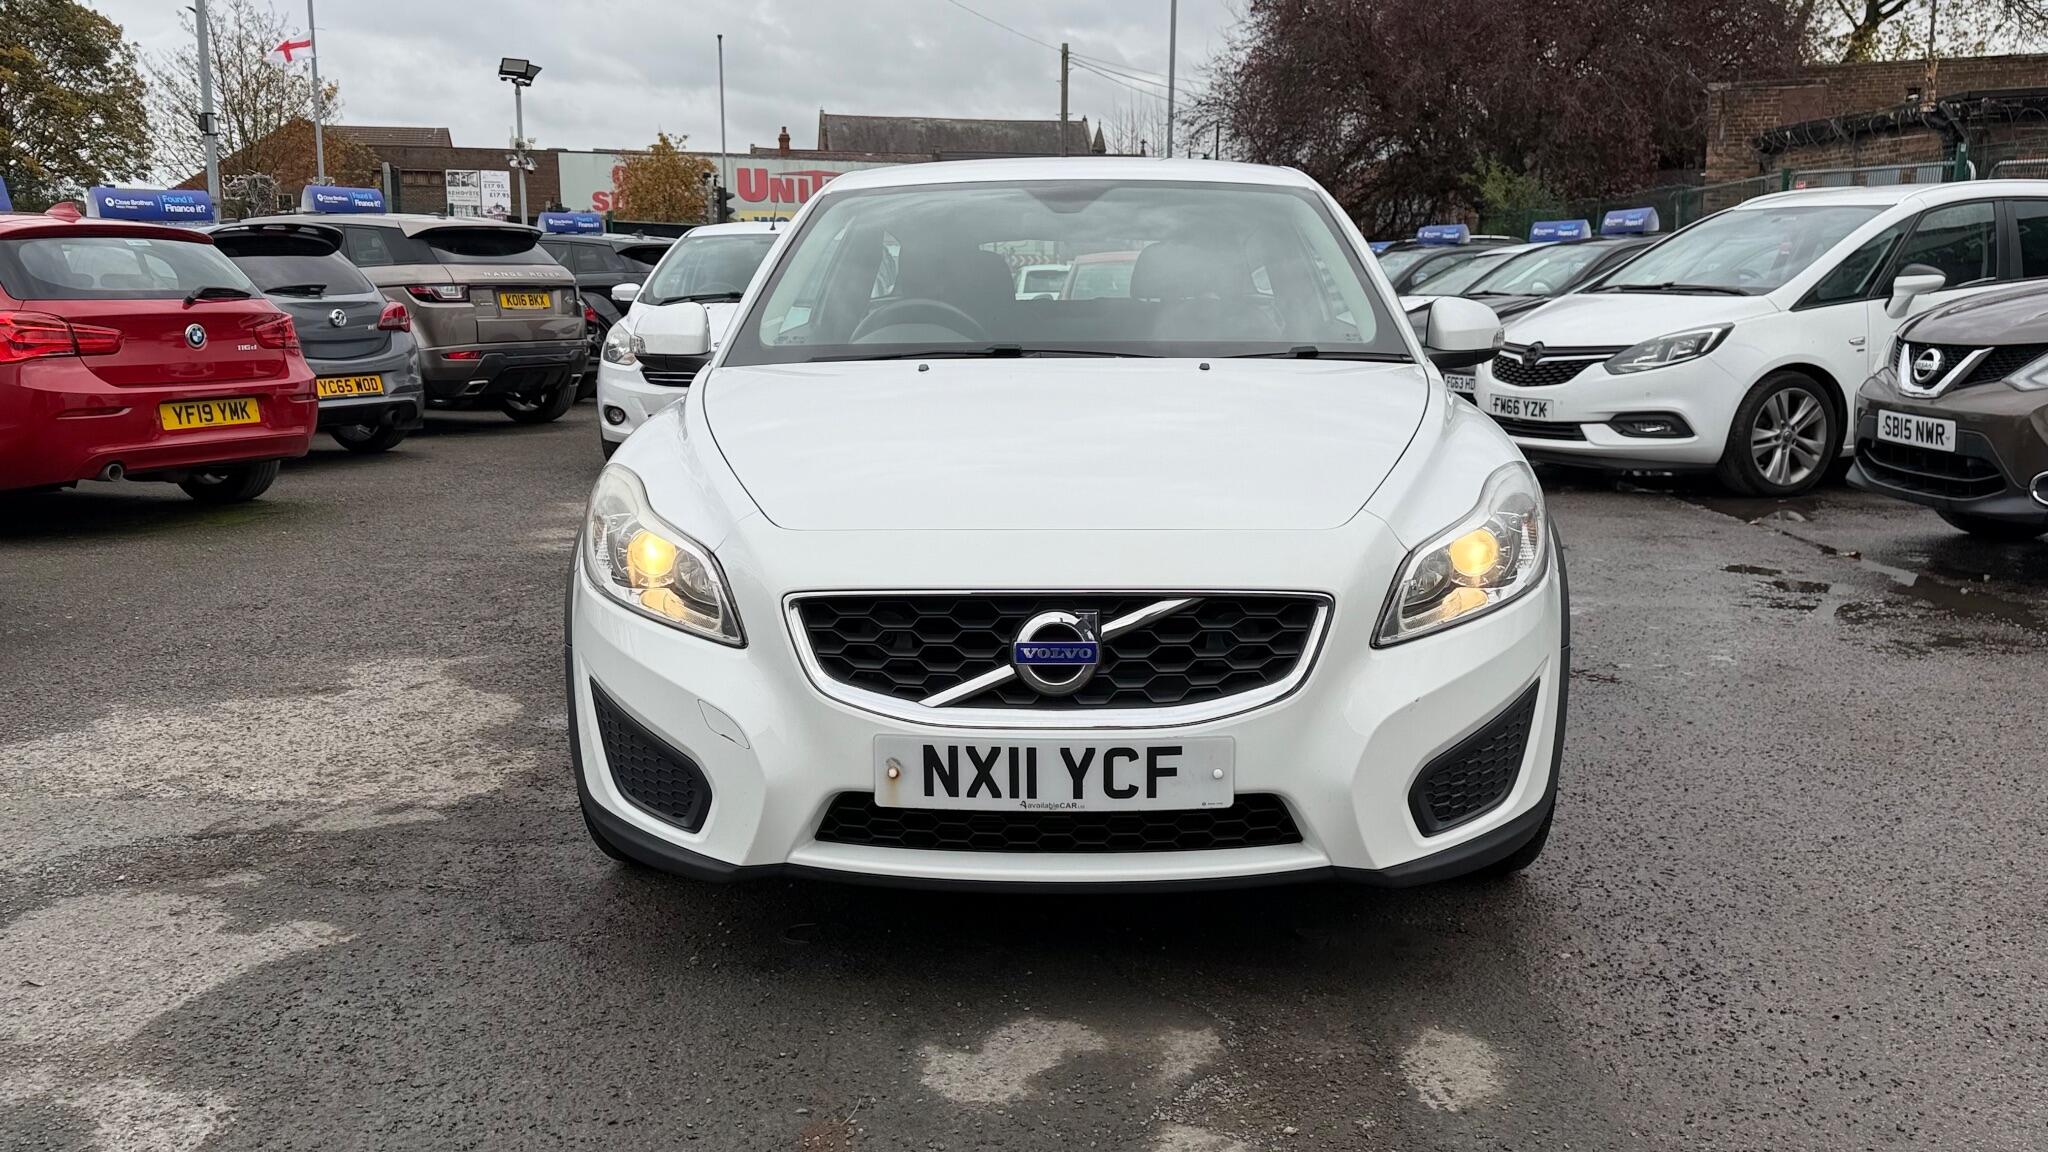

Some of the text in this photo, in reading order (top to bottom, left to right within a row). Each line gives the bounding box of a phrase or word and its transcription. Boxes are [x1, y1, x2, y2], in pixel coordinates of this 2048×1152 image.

[737, 168, 844, 204] UNIT
[164, 203, 206, 213] Finance it?
[528, 295, 546, 306] BKX
[319, 379, 353, 394] YC65
[1447, 376, 1476, 391] FG63 HD
[172, 401, 251, 425] YF19 YMK
[1493, 397, 1548, 418] FW66 YZK
[1884, 415, 1945, 446] SB15 NWR
[1020, 647, 1093, 659] VOLVO
[922, 744, 1183, 799] NX11 YCF
